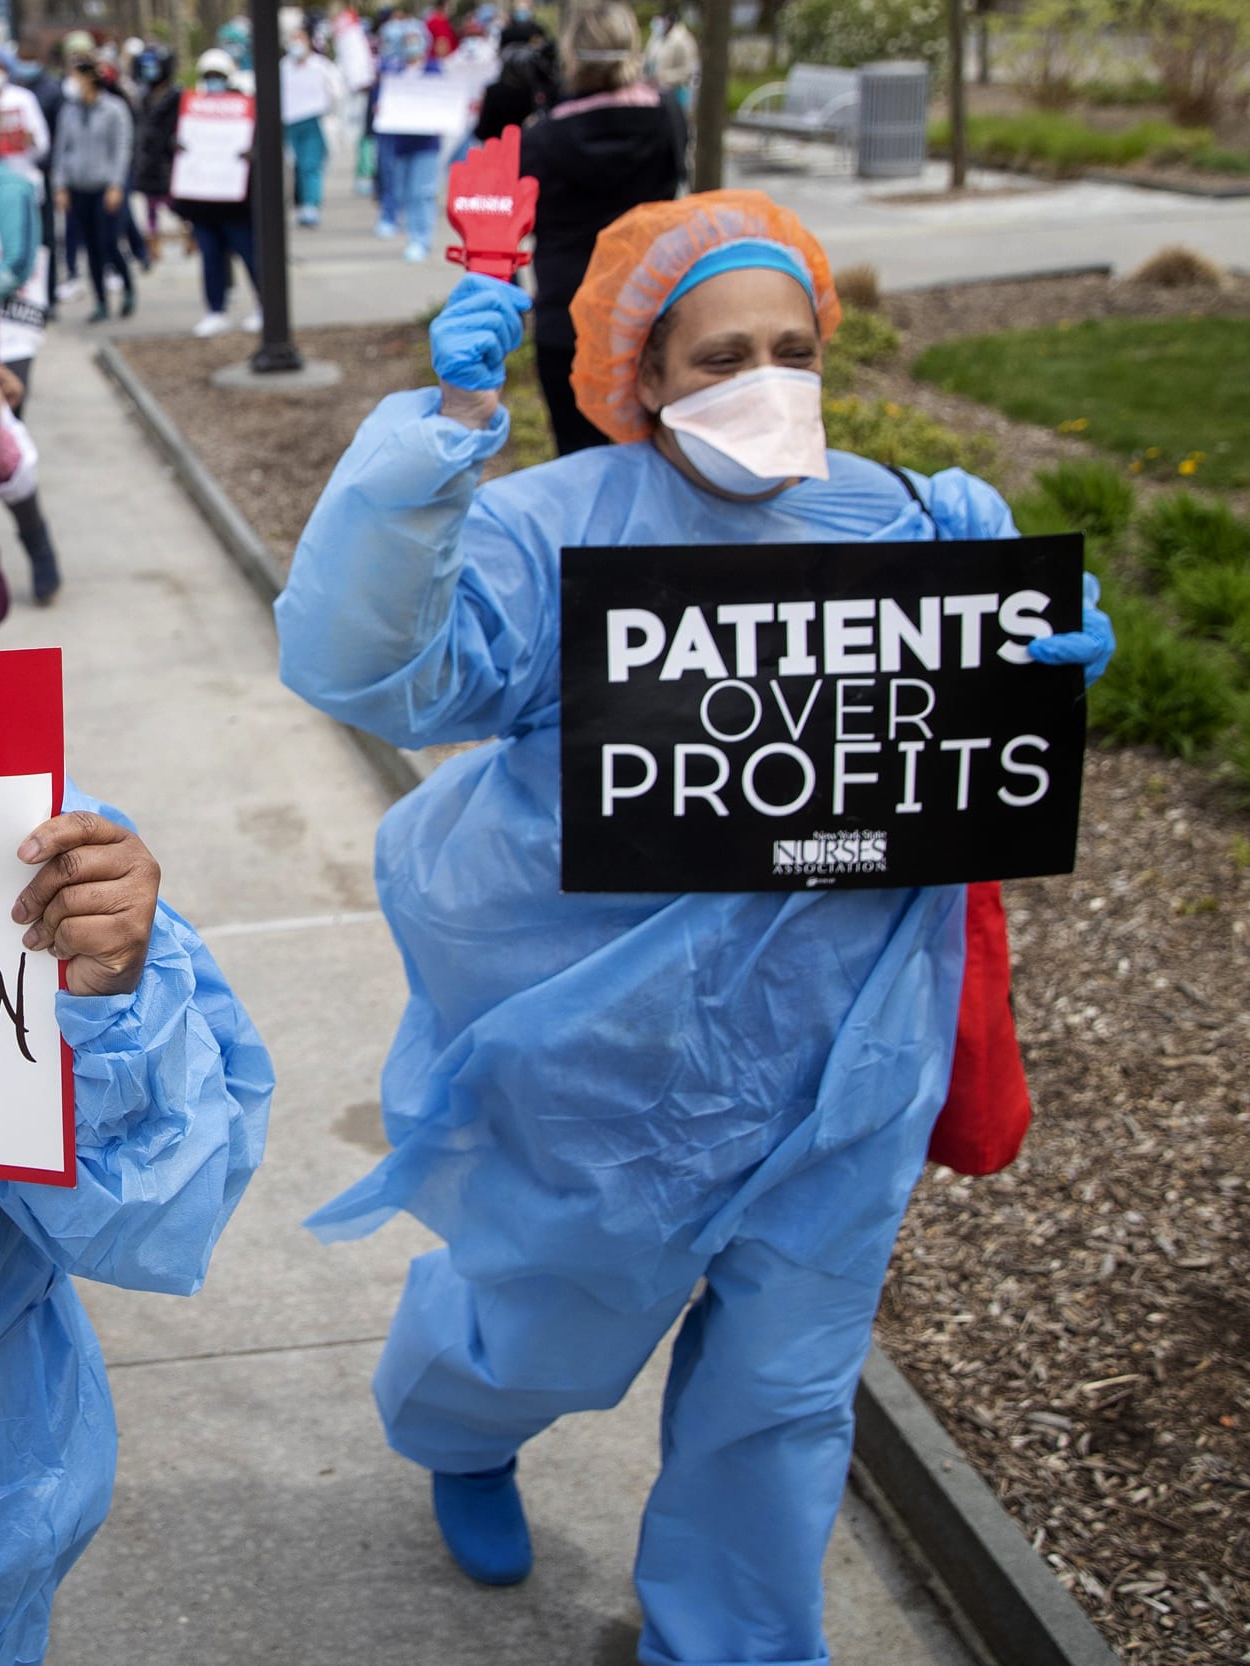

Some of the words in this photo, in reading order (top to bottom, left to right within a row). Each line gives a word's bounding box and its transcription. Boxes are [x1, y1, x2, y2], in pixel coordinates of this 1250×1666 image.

[607, 589, 1053, 683] PATIENTS
[700, 678, 936, 743] OVER
[601, 734, 1052, 817] PROFITS
[772, 840, 888, 865] NURSES
[772, 860, 888, 875] ASSOCIATION
